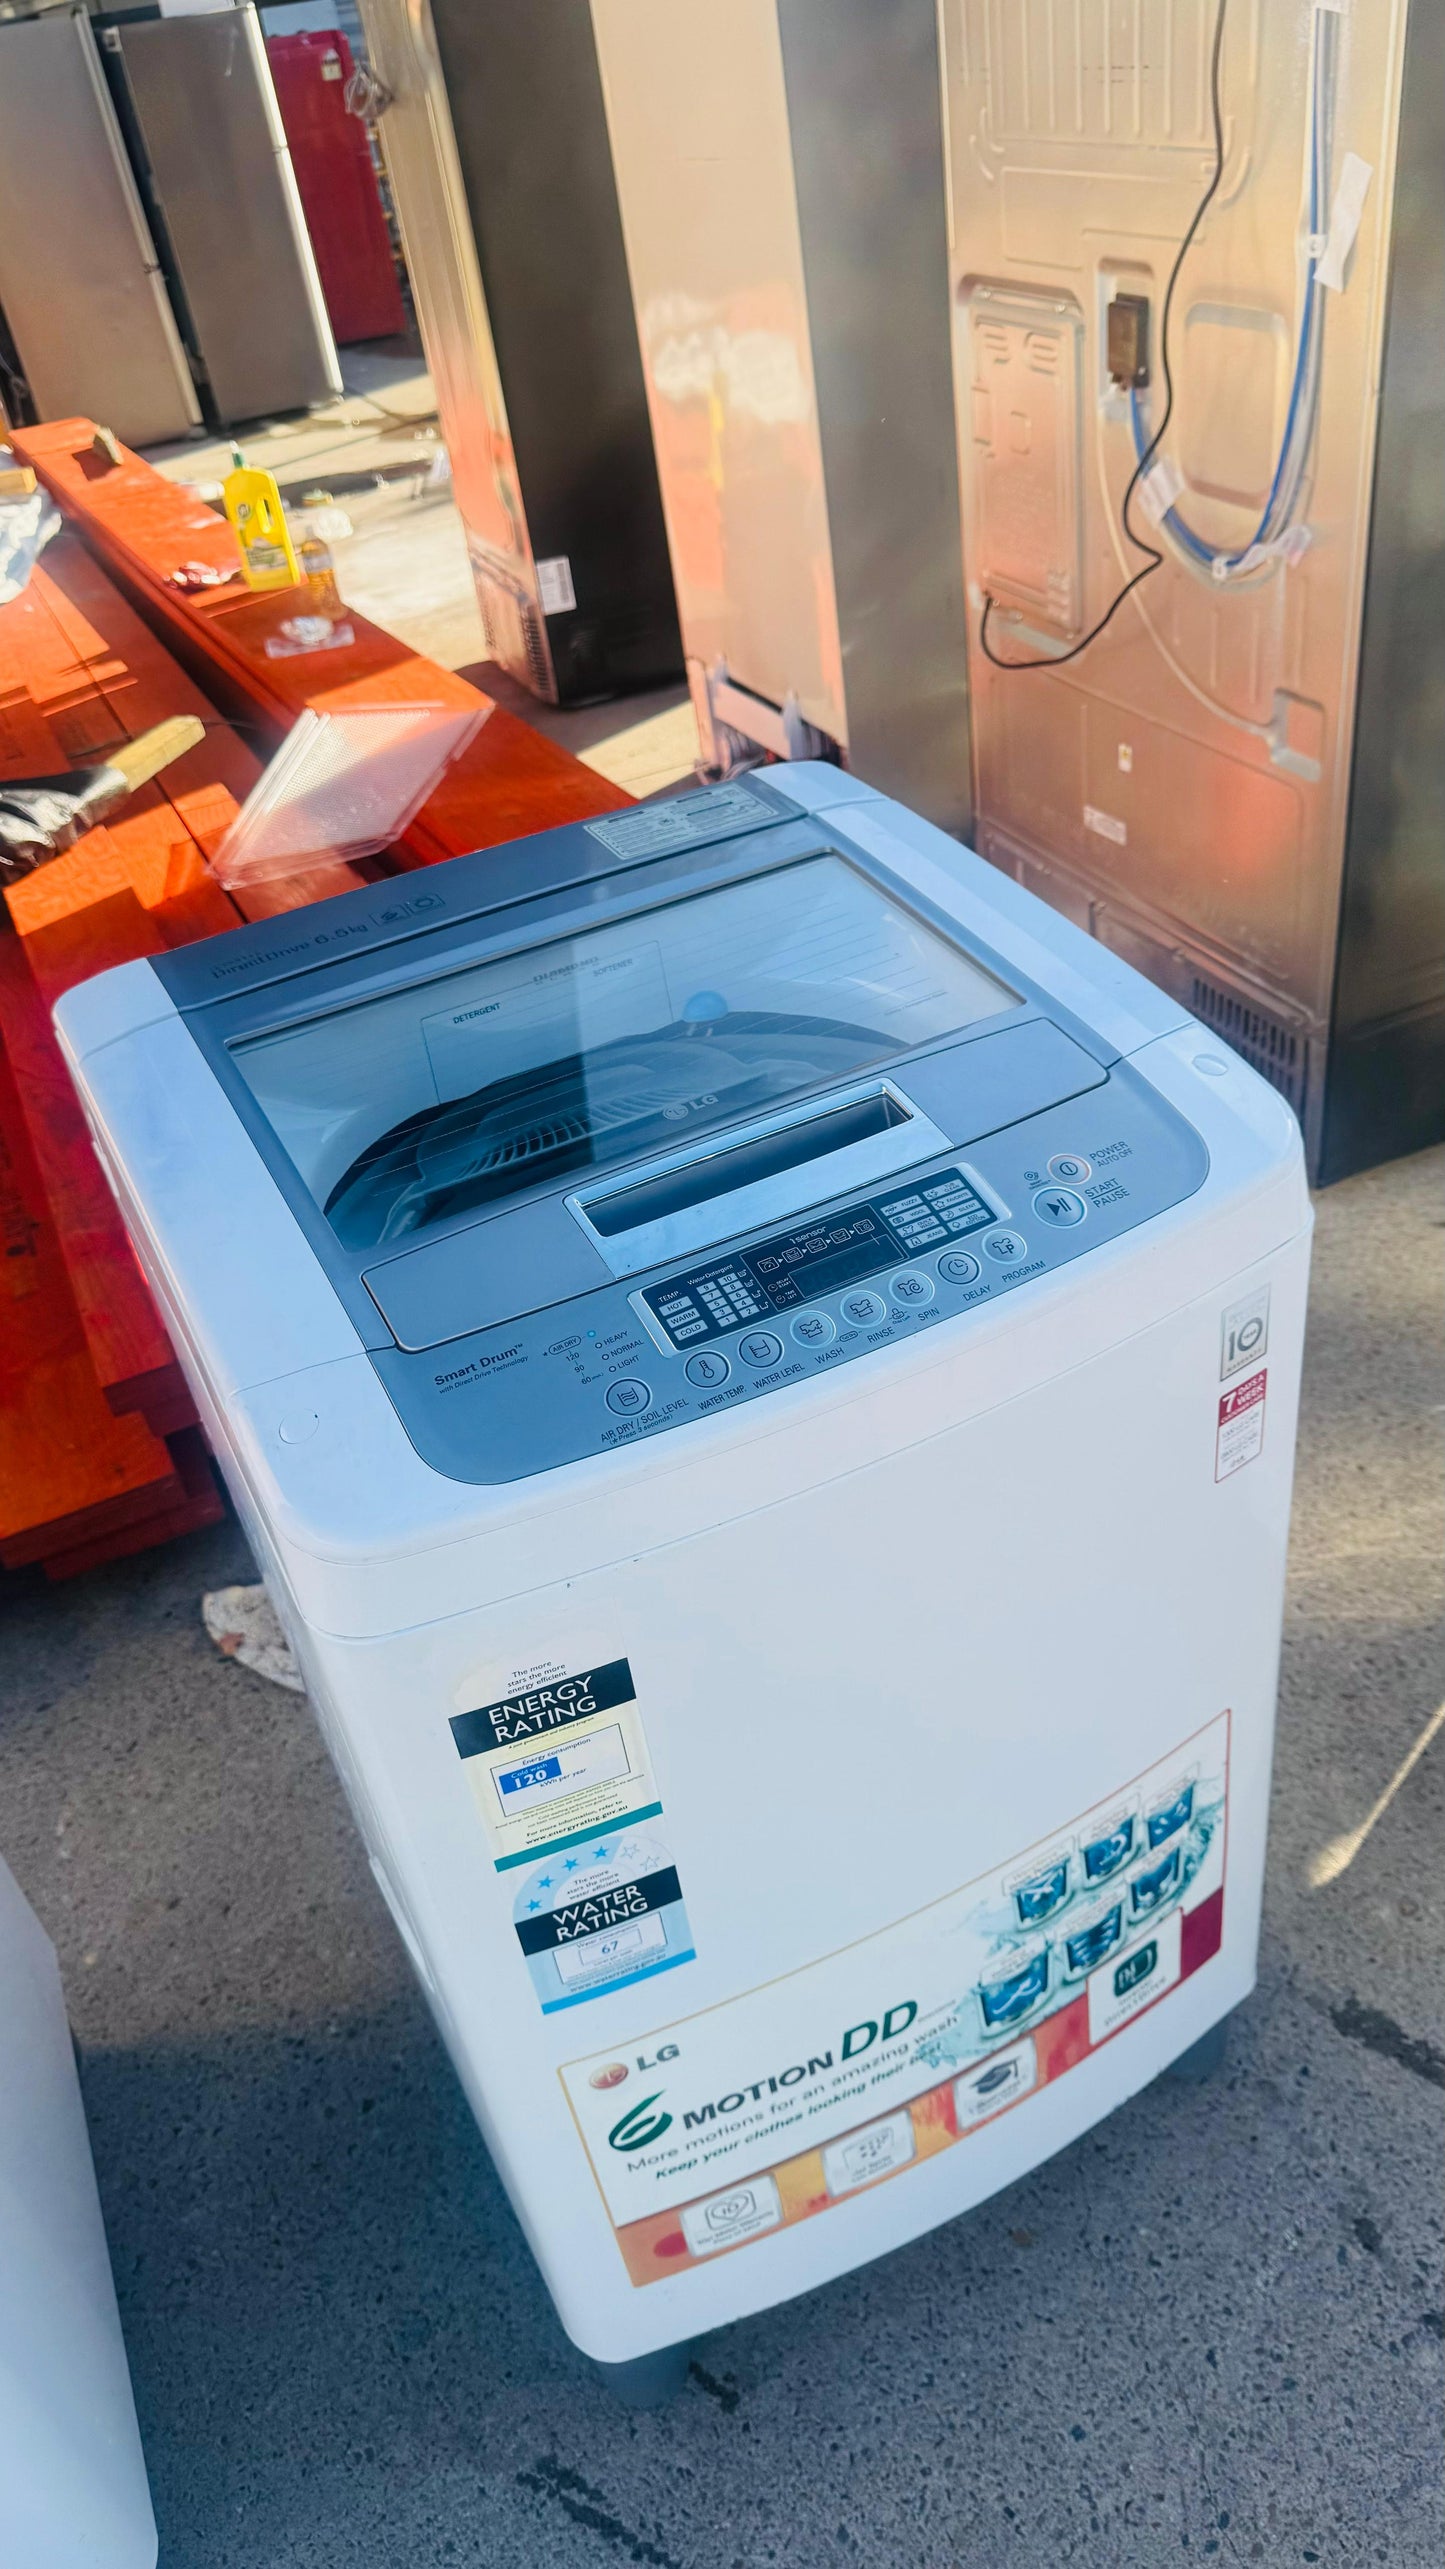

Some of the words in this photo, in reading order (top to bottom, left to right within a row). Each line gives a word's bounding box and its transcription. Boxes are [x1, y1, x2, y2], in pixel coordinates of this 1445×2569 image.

[453, 1002, 501, 1024] DETERGENT
[689, 1095, 719, 1110] LG
[1089, 1141, 1128, 1161] POWER
[1097, 1155, 1118, 1167] AUTO
[1118, 1147, 1133, 1159] OFF
[1084, 1178, 1120, 1198] START
[1093, 1188, 1130, 1208] PAUSE
[1001, 1260, 1046, 1283] PROGRAM
[963, 1284, 992, 1302] DELAY
[667, 1301, 684, 1311] HOT
[917, 1307, 940, 1321] SPIN
[671, 1311, 696, 1325] WARM
[604, 1331, 628, 1345] HEAVY
[680, 1324, 701, 1337] COLD
[867, 1326, 895, 1343] RINSE
[1228, 1317, 1263, 1361] 10
[553, 1344, 564, 1352] AIR
[564, 1338, 577, 1347] DRY
[611, 1340, 644, 1357] NORMAL
[566, 1352, 579, 1362] 120
[617, 1355, 639, 1369] LIGHT
[814, 1347, 845, 1364] WASH
[434, 1363, 478, 1386] Smart
[439, 1385, 454, 1394] with
[454, 1377, 474, 1388] Direct
[475, 1370, 491, 1380] Drive
[492, 1356, 529, 1373] Technology
[753, 1373, 784, 1389] WATER
[782, 1363, 805, 1378] LEVEL
[698, 1393, 725, 1411] WATER
[724, 1384, 747, 1399] TEMP.
[1222, 1391, 1237, 1413] 7
[1237, 1383, 1264, 1405] WEEK
[601, 1430, 616, 1442] AIR
[616, 1421, 634, 1435] DRY
[641, 1411, 662, 1424] SOIL
[662, 1398, 689, 1415] LEVEL
[643, 1414, 673, 1430] seconds)
[507, 1678, 527, 1687] stars
[544, 1664, 566, 1675] more
[530, 1661, 552, 1672] more
[507, 1683, 534, 1695] energy
[536, 1670, 567, 1685] efficient
[488, 1675, 592, 1725] ENERGY
[494, 1695, 597, 1743] RATING
[523, 1755, 546, 1767] Energy
[547, 1738, 591, 1757] consumption
[511, 1769, 528, 1778] Cold
[530, 1763, 548, 1771] wash
[515, 1769, 547, 1788] 120
[540, 1779, 557, 1788] kWh
[559, 1774, 570, 1782] per
[572, 1768, 586, 1777] year
[540, 1825, 557, 1833] more
[553, 1884, 642, 1925] WATER
[556, 1897, 649, 1942] RATING
[602, 1940, 618, 1954] 67
[636, 2044, 680, 2072] LG
[608, 2088, 673, 2151] 6
[683, 2050, 833, 2130] MOTION
[841, 2000, 918, 2062] DD
[627, 2149, 679, 2172] More
[686, 2113, 764, 2151] motions
[770, 2099, 795, 2115] for
[803, 2085, 825, 2100] an
[832, 2043, 909, 2087] amazing
[914, 2015, 958, 2044] wash
[656, 2158, 698, 2180] Keep
[703, 2140, 740, 2164] your
[745, 2113, 803, 2144] clothes
[808, 2081, 866, 2115] looking
[871, 2063, 905, 2086] their
